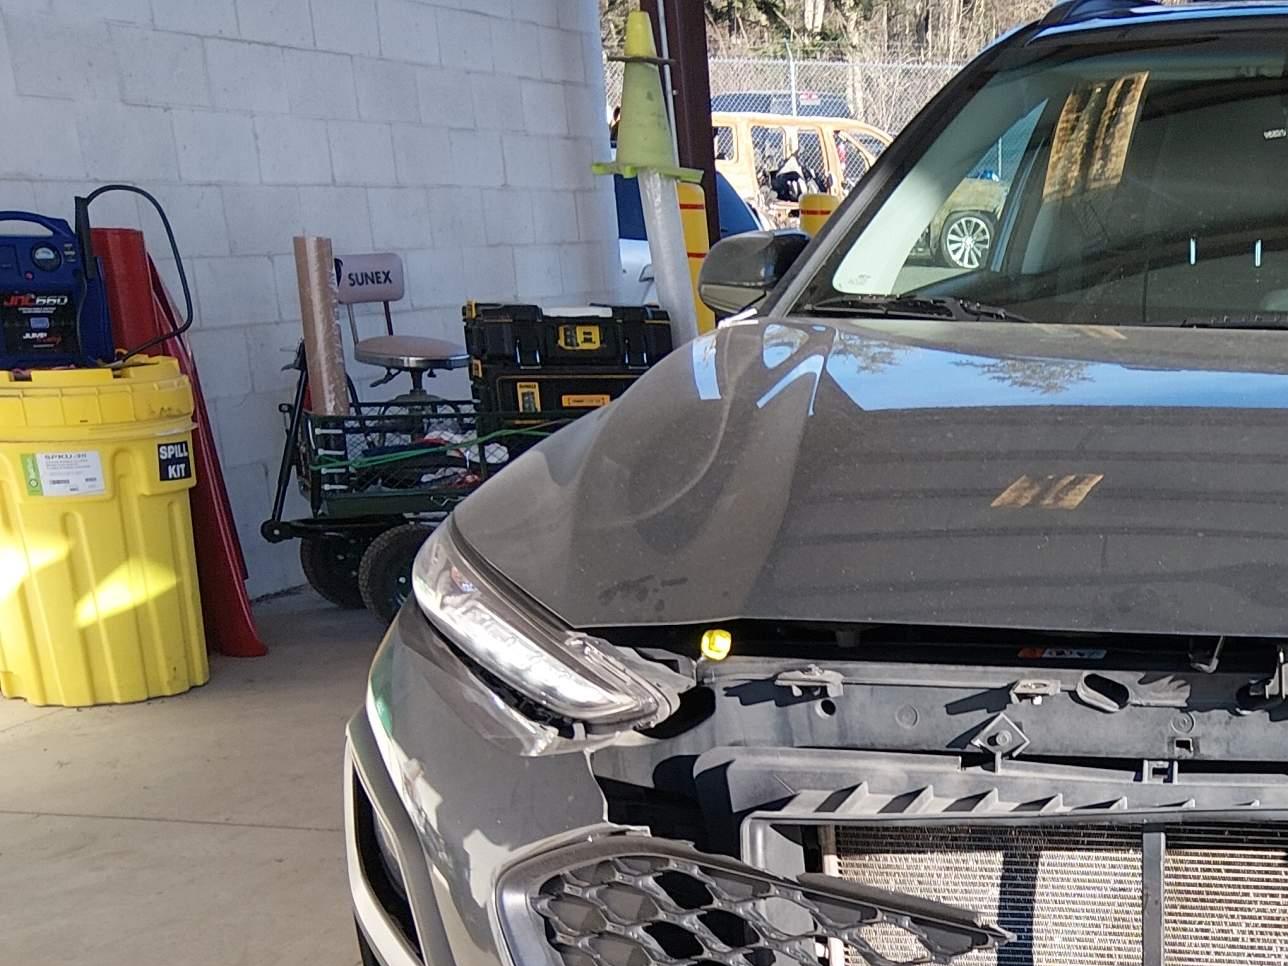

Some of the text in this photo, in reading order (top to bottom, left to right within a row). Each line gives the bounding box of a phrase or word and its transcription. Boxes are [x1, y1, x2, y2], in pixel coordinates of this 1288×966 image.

[348, 270, 392, 287] SUNEX
[160, 443, 189, 460] SPILL
[168, 463, 186, 480] KIT
